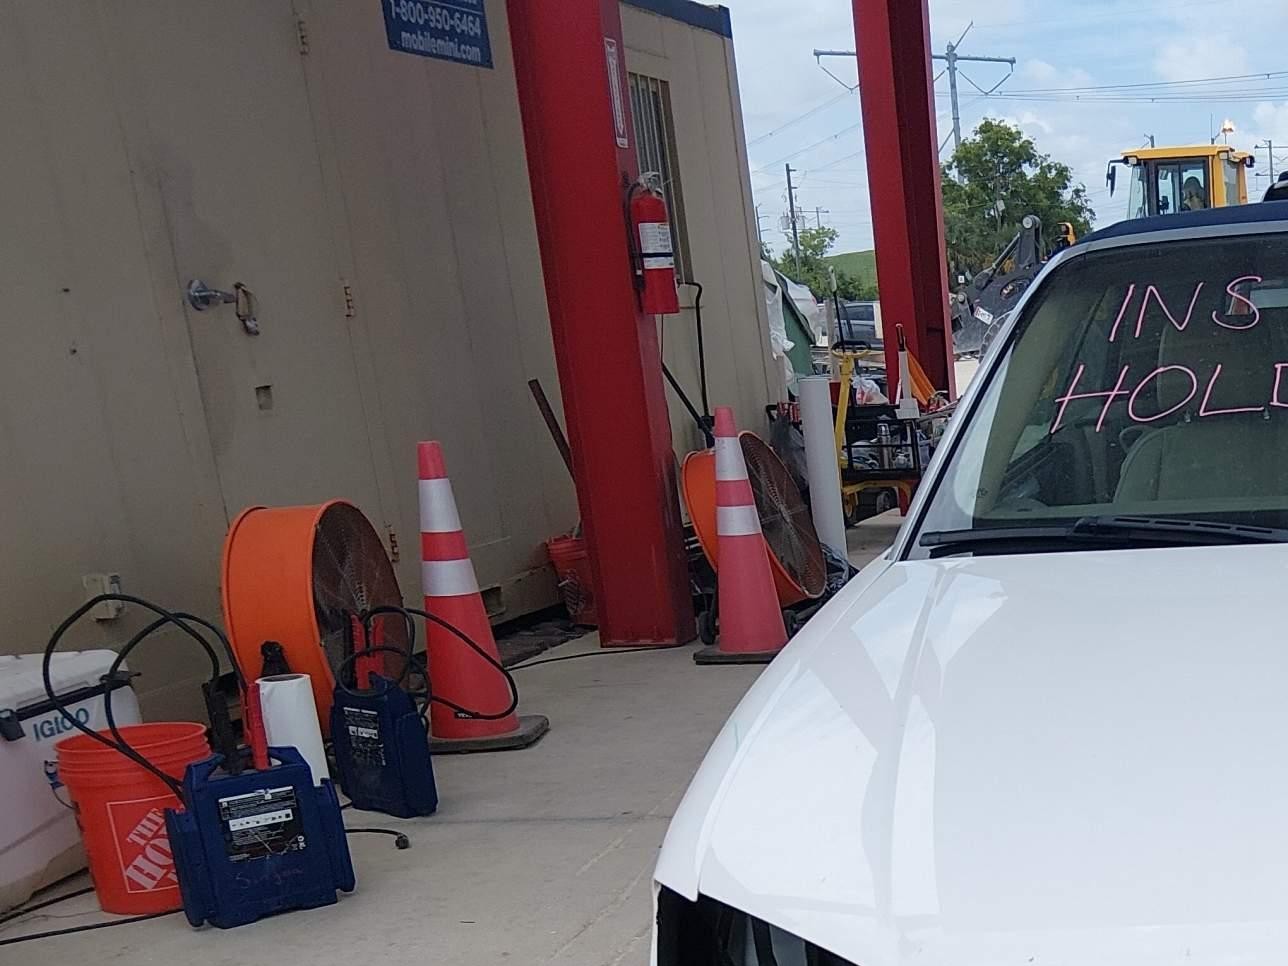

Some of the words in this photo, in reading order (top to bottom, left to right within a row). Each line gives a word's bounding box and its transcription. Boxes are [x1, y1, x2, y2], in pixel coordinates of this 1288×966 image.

[390, 0, 481, 36] 1-800-950-6464
[401, 31, 481, 61] mobilemini.com
[1109, 275, 1262, 342] INS
